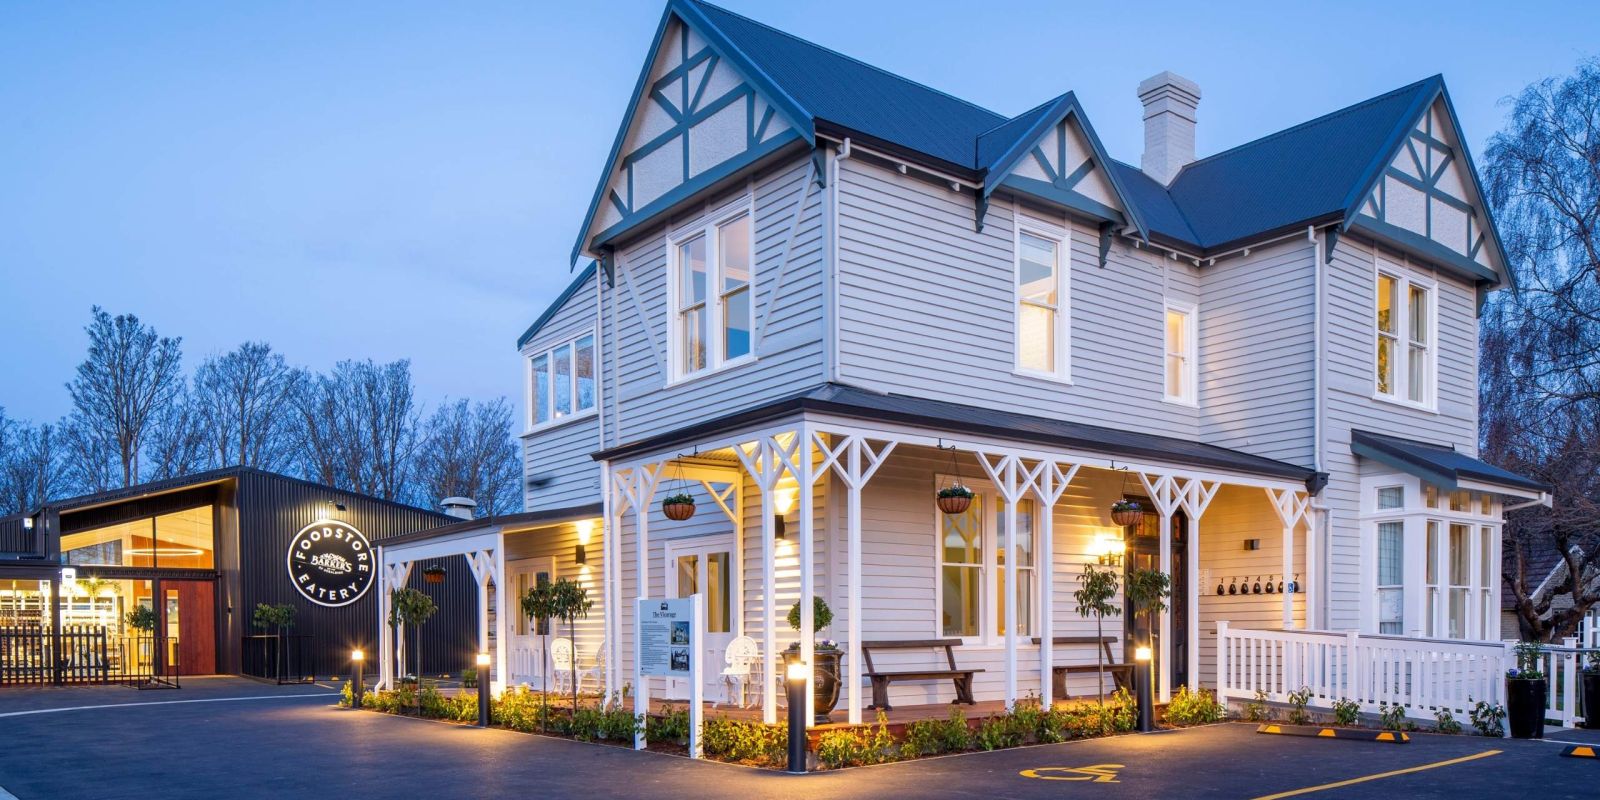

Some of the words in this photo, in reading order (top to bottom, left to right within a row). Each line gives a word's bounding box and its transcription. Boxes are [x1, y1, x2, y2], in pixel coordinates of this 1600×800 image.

[296, 527, 368, 572] FOODSTORE
[310, 555, 352, 573] BARKER'S
[298, 573, 358, 600] EATERY
